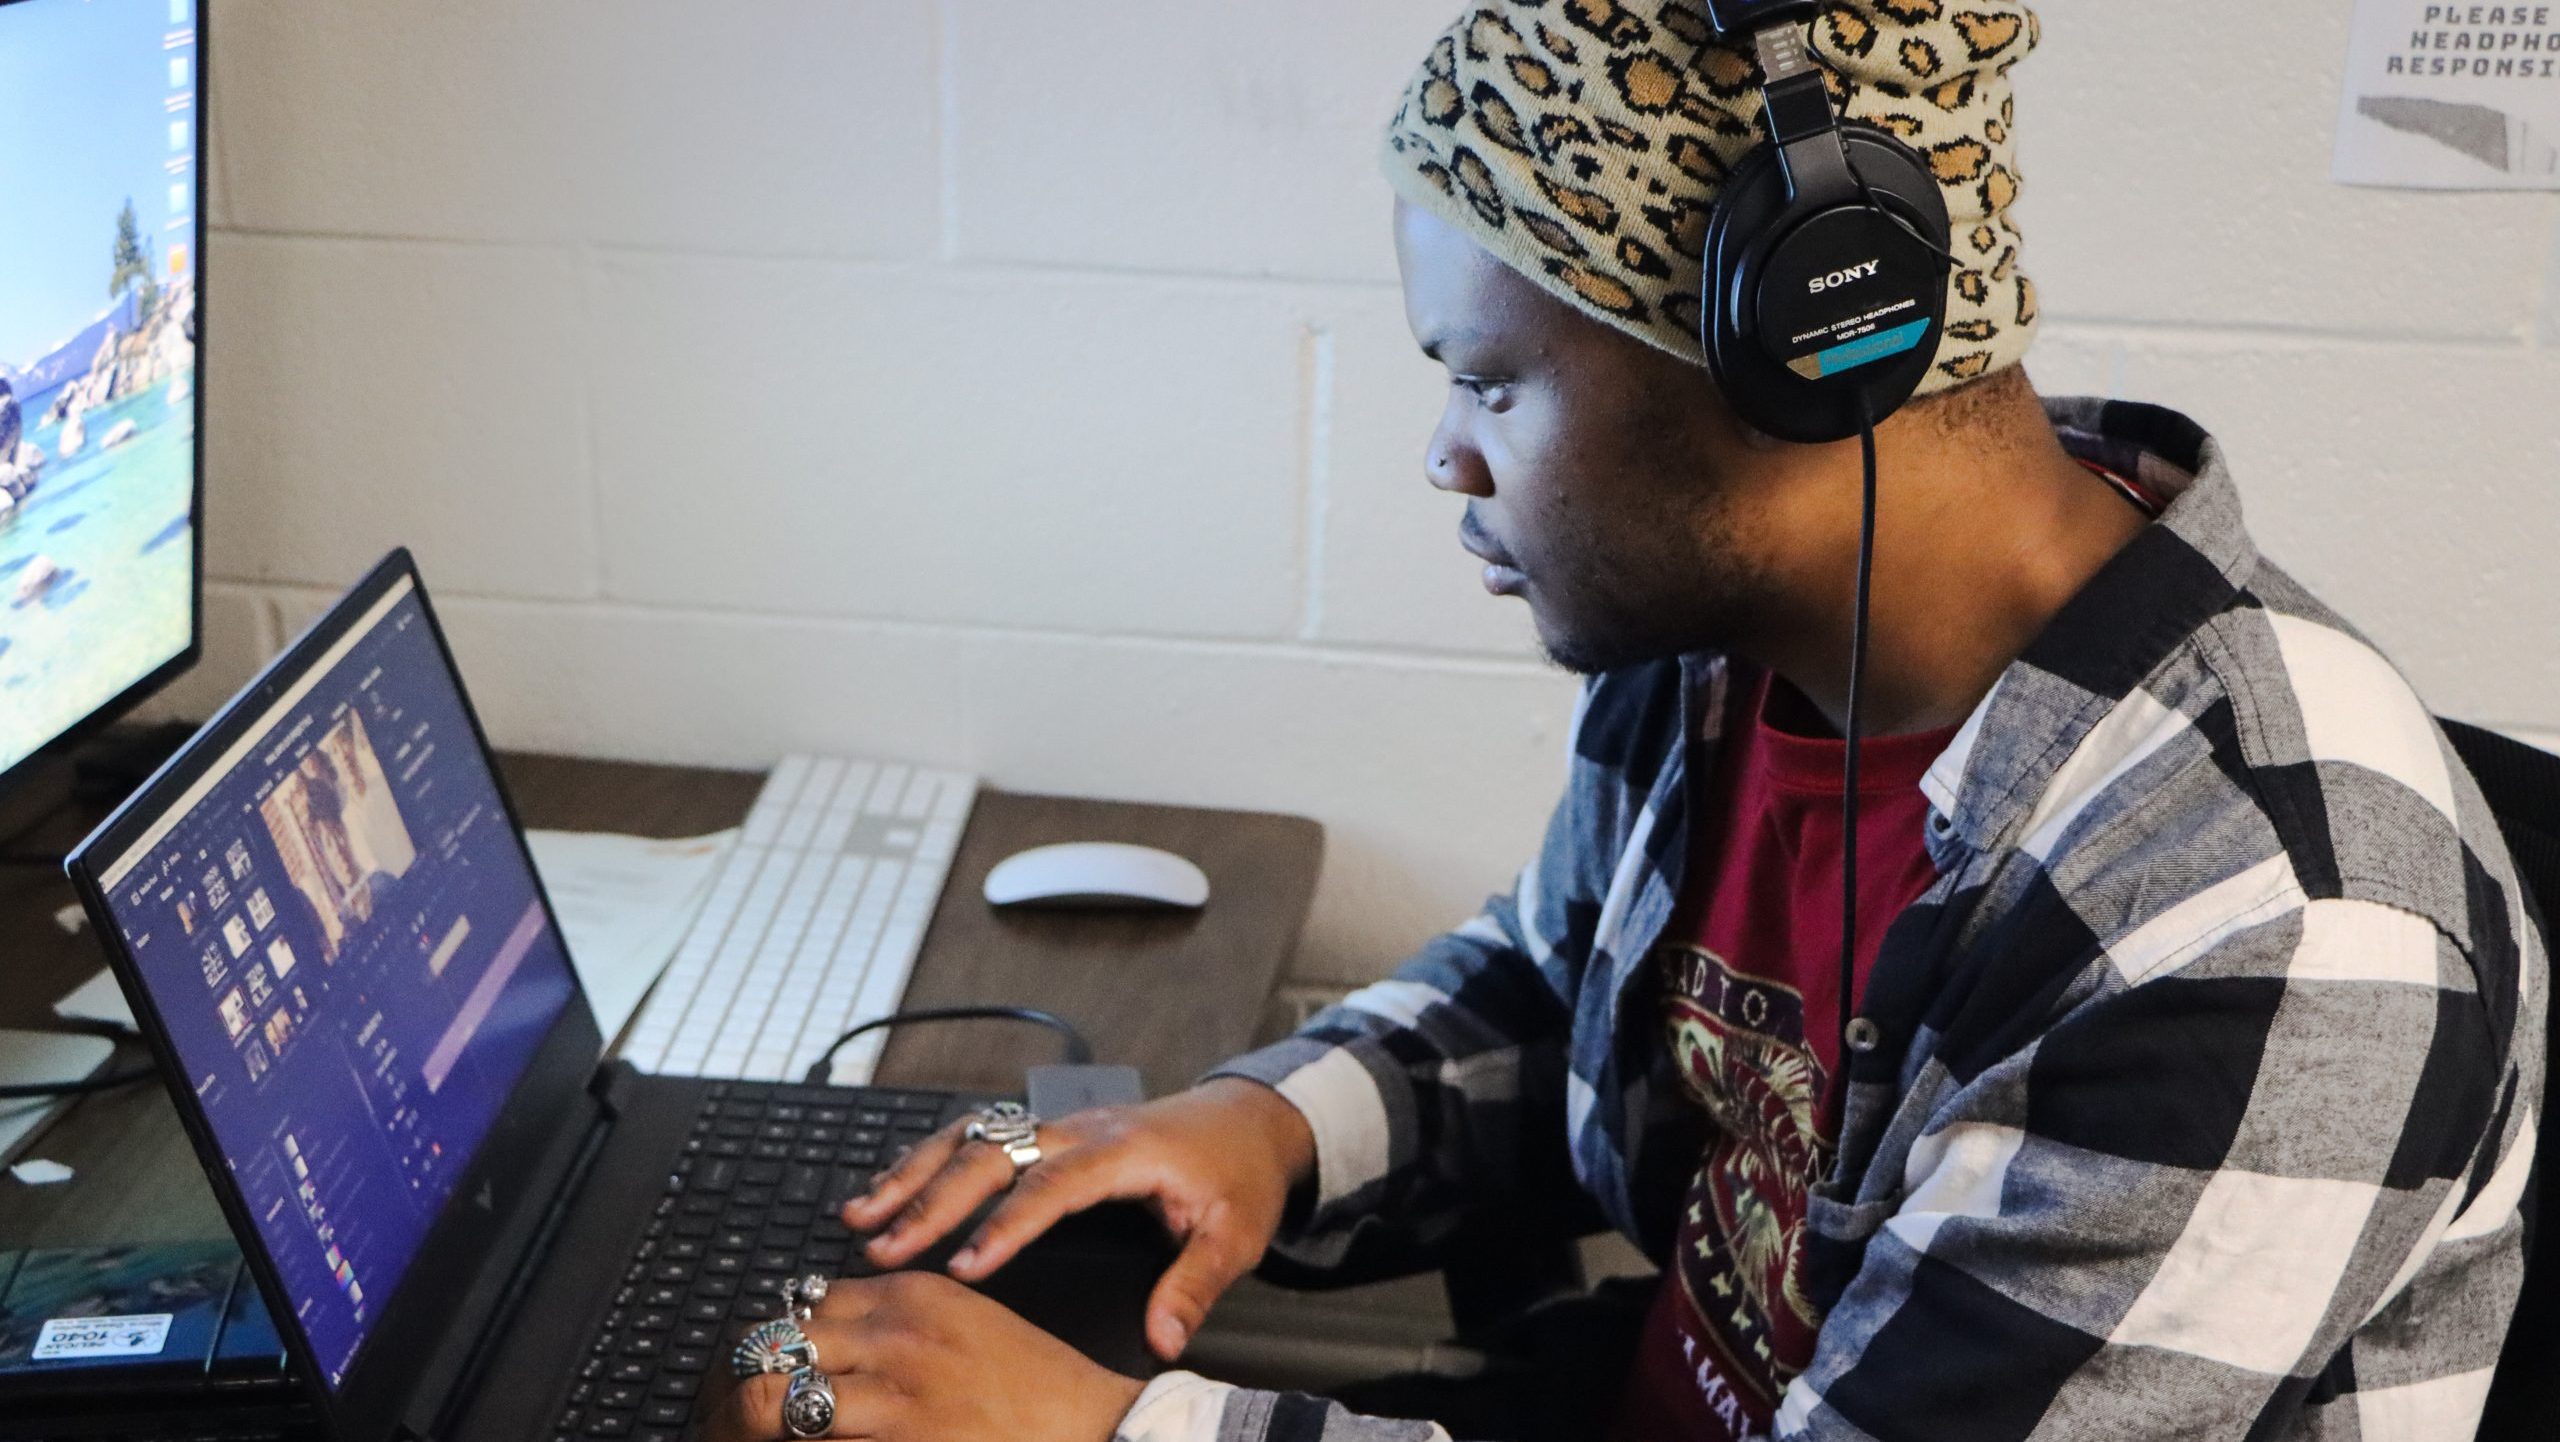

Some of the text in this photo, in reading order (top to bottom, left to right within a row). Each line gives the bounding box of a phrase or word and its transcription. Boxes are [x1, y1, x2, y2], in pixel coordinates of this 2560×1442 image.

[2424, 6, 2550, 26] PLEASE
[2387, 56, 2560, 78] RESPONSI
[1808, 259, 1880, 294] SONY
[1792, 298, 1916, 344] DYNAMIC STEREO HEADPHONES
[52, 1331, 108, 1342] 1040
